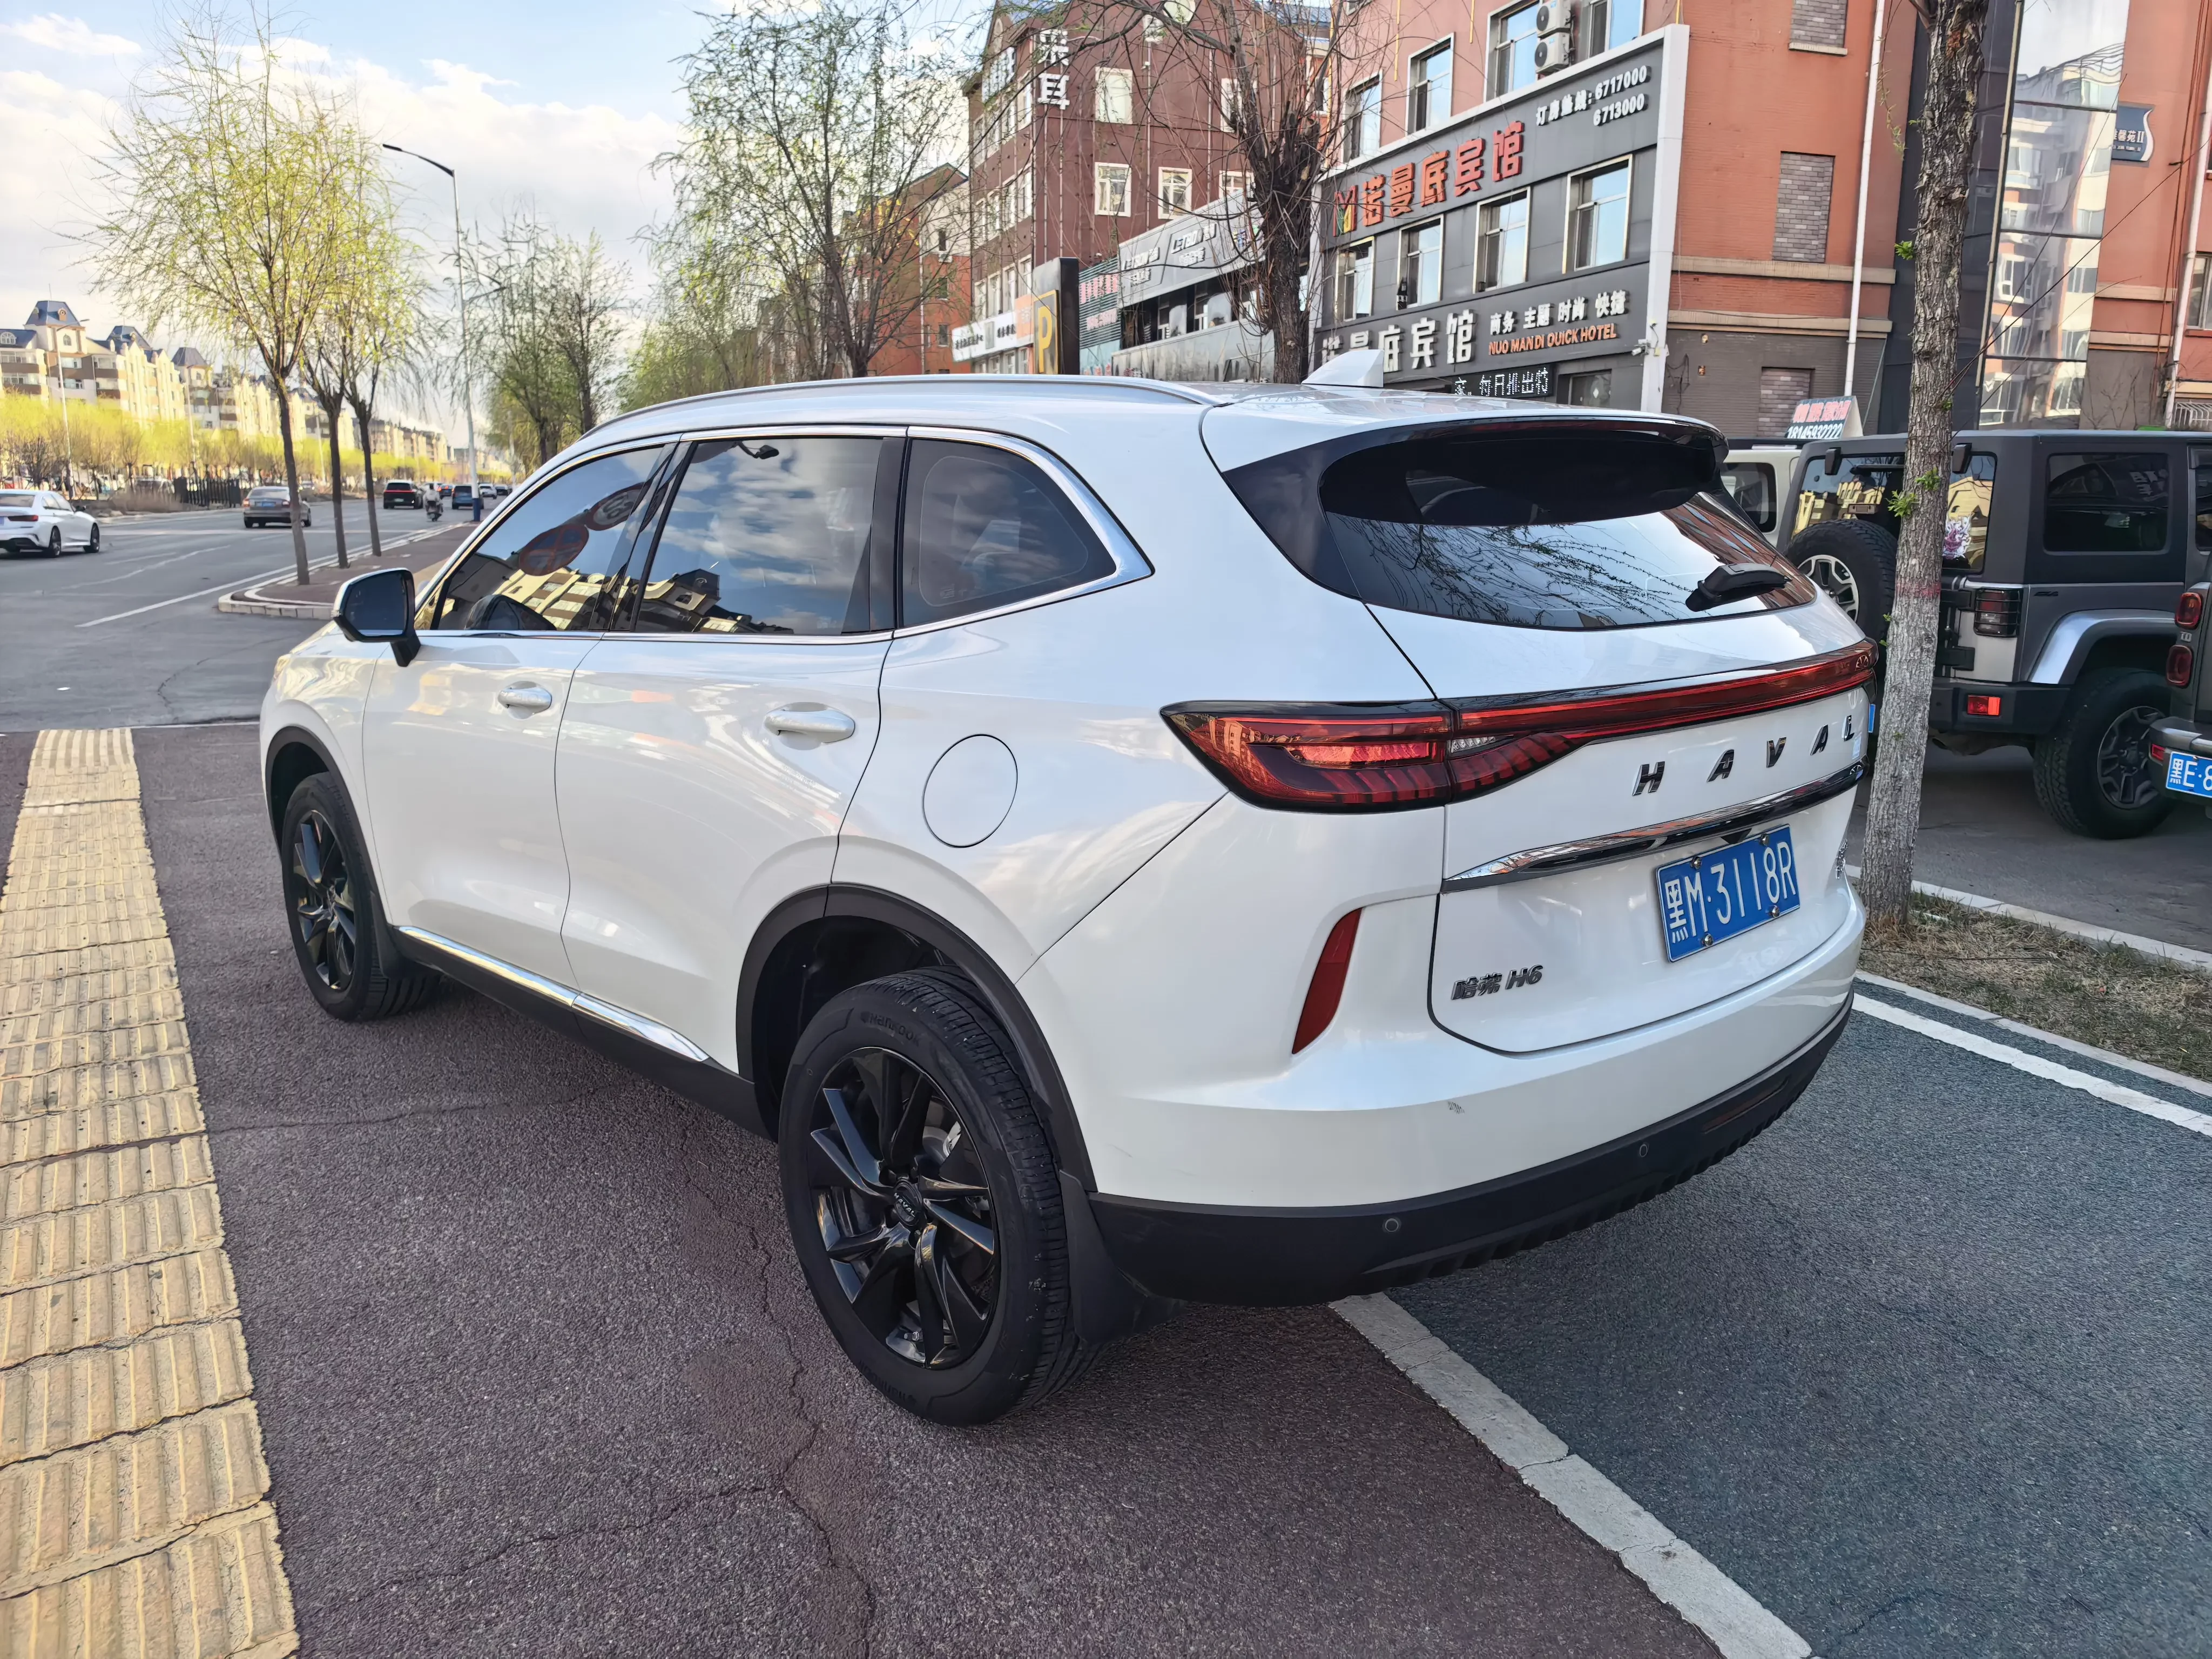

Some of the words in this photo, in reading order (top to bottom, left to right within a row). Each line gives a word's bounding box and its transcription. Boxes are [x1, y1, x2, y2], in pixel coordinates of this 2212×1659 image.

[1594, 93, 1644, 126] 6713000
[1490, 310, 1514, 335] 商务
[1523, 303, 1550, 329] 主题
[1558, 296, 1586, 323] 时尚
[1595, 289, 1626, 318] 快捷
[1488, 340, 1509, 355] NUO
[1580, 323, 1617, 342] HOTEL
[1632, 715, 1855, 797] HAVAL
[1451, 973, 1502, 1000] 哈弗
[1505, 965, 1543, 990] H6
[894, 1192, 915, 1217] HAVAL
